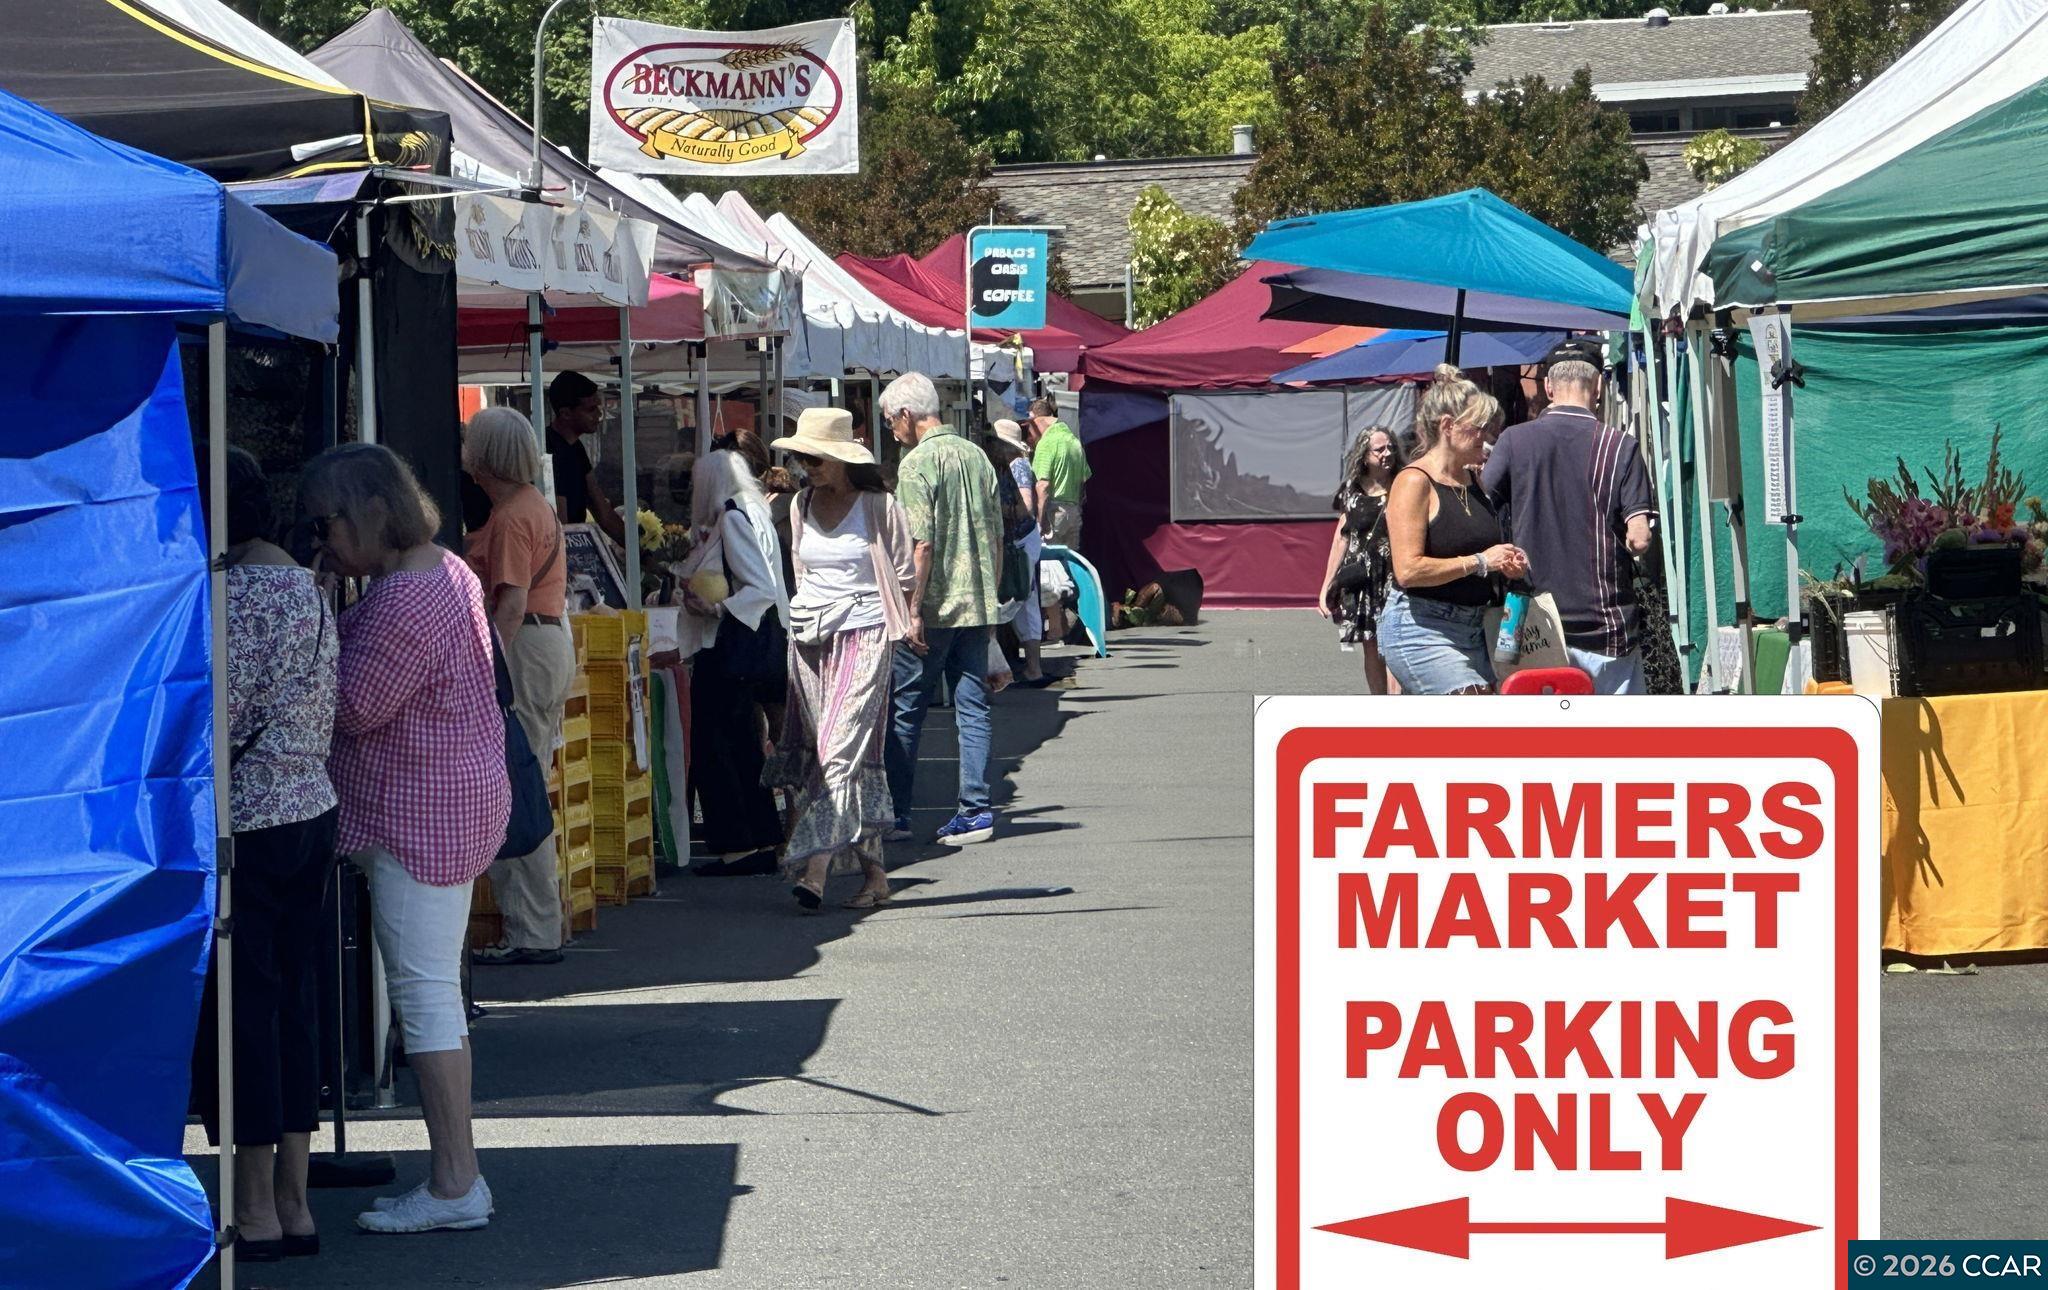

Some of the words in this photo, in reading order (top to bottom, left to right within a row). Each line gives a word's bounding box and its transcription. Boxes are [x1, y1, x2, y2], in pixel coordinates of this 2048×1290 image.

[632, 62, 811, 100] BECKMANN'S
[671, 138, 734, 161] Naturally
[739, 137, 777, 156] Good
[984, 247, 1036, 259] PABLO'S
[990, 263, 1029, 275] OASIS
[982, 289, 1036, 303] COFFEE
[566, 533, 593, 548] ASTA
[1313, 781, 1824, 859] FARMERS
[1338, 873, 1800, 948] MARKET
[1346, 1000, 1796, 1080] PARKING
[1437, 1092, 1707, 1172] ONLY
